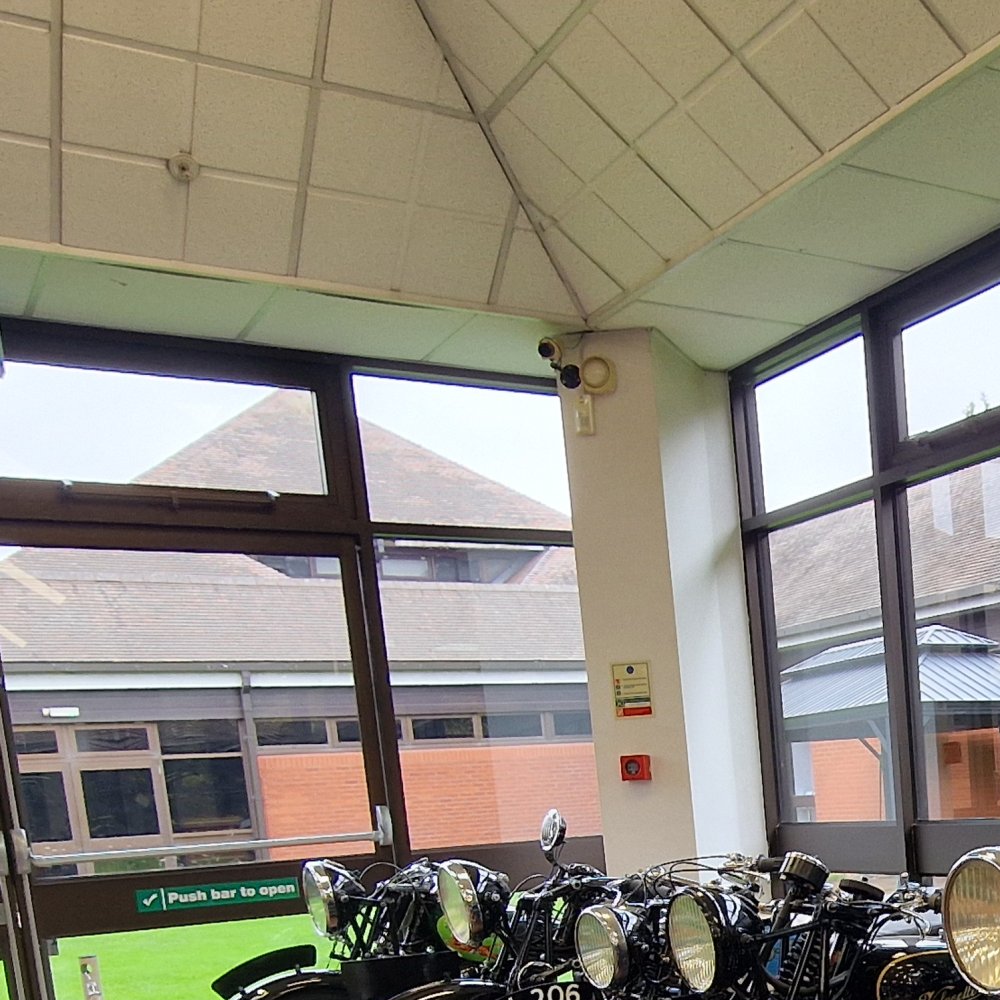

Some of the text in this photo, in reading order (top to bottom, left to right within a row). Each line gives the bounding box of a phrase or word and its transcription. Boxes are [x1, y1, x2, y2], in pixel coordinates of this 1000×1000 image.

[168, 883, 295, 904] Push bar to open
